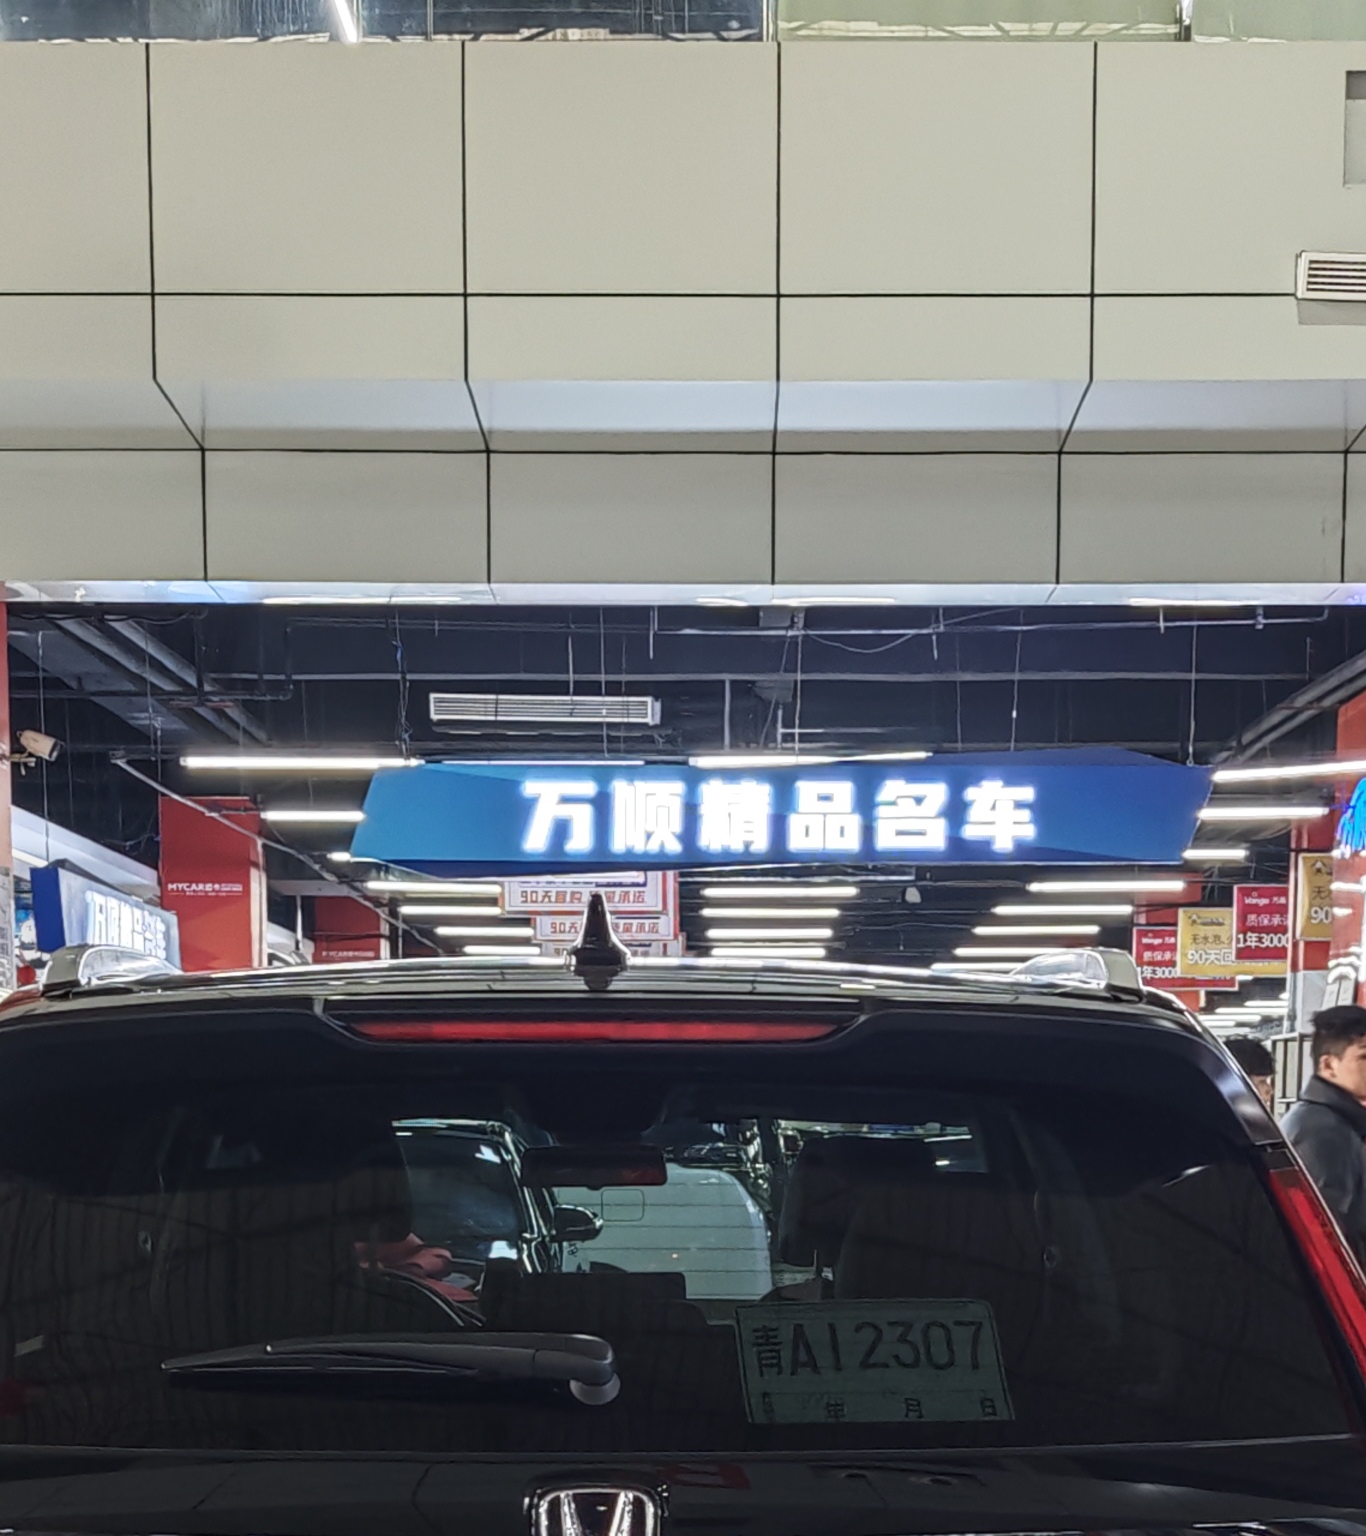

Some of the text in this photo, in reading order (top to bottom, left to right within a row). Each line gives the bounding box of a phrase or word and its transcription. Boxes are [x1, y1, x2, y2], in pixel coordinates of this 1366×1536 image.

[521, 777, 1036, 855] 万顺精品名车
